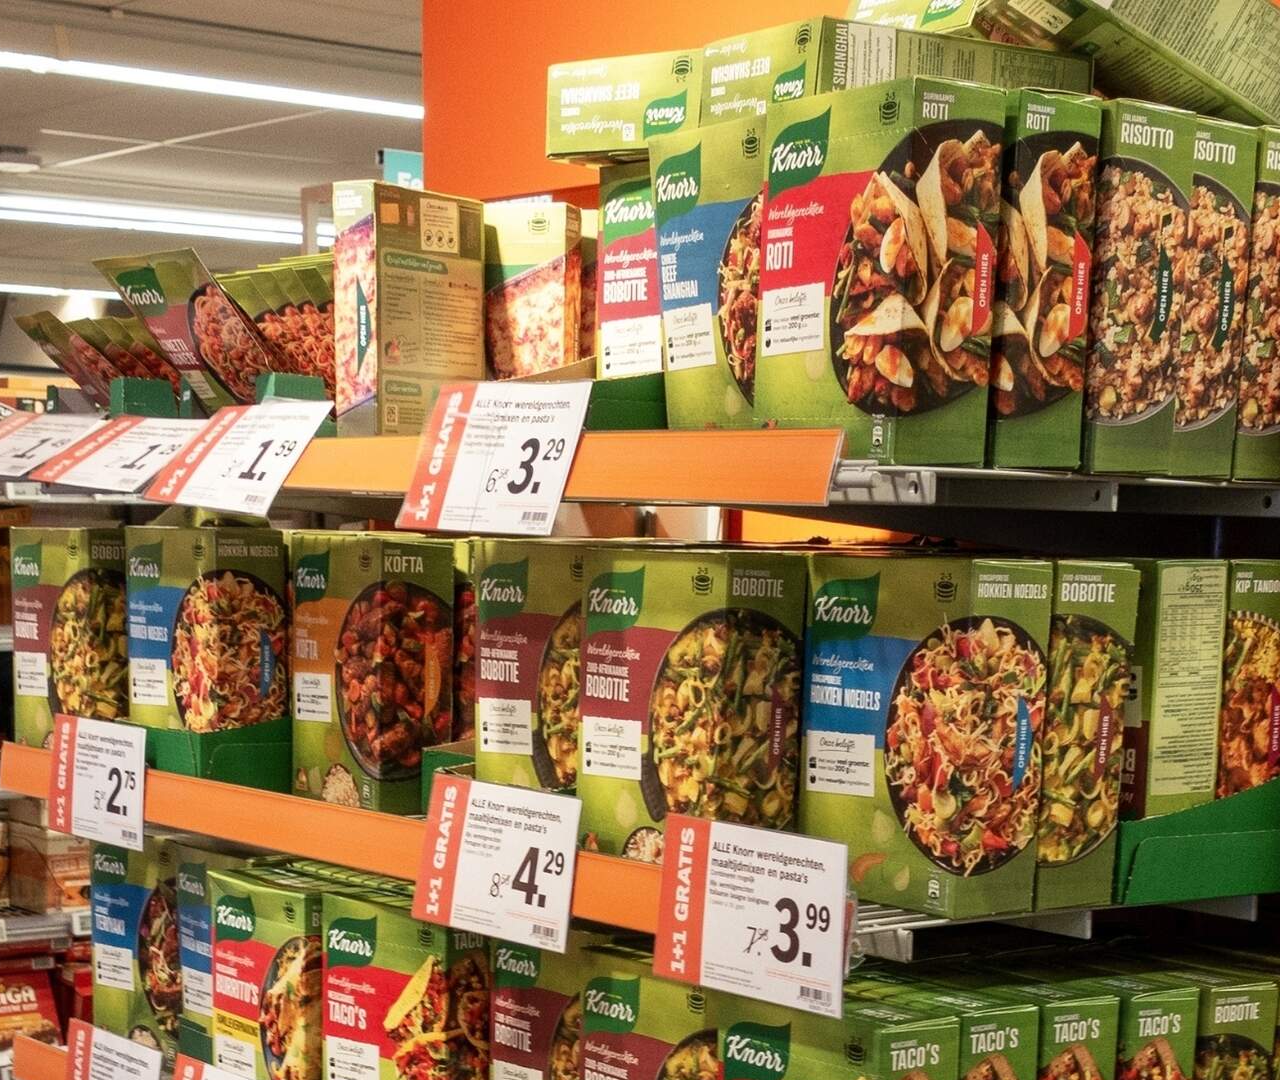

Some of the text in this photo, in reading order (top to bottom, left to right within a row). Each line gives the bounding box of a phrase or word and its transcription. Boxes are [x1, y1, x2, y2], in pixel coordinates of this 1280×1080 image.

[833, 23, 848, 84] SHANGHAI
[774, 79, 805, 98] Knorr
[645, 105, 686, 124] Knorr
[922, 103, 949, 120] ROTI
[1026, 113, 1051, 132] ROTI
[1121, 124, 1174, 152] RISOTTO
[771, 143, 823, 174] Knorr
[657, 174, 699, 203] Knorr
[605, 200, 656, 225] Knorr
[768, 202, 825, 222] Wereldgerechten
[766, 241, 794, 272] ROTI
[662, 266, 678, 283] BEEF
[979, 252, 990, 308] OPEN HIER
[1075, 261, 1087, 315] OPEN HIER
[121, 286, 165, 307] Knorr
[604, 279, 648, 304] BOBOTIE
[663, 280, 699, 301] SHANGHAI
[1158, 269, 1171, 323] OPEN HIER
[1220, 280, 1232, 332] OPEN HIER
[14, 557, 40, 577] Knorr
[129, 557, 160, 578] Knorr
[296, 566, 326, 590] Knorr
[383, 556, 424, 573] KOFTA
[480, 577, 525, 604] Knorr
[732, 577, 784, 598] BOBOTIE
[978, 582, 1048, 601] HOKKIEN NOEDELS
[1061, 582, 1117, 604] BOBOTIE
[1235, 579, 1251, 593] KIP
[589, 586, 639, 616] Knorr
[814, 595, 873, 626] Knorr
[480, 658, 520, 684] BOBOTIE
[812, 652, 875, 674] Wereldgerechten
[585, 674, 630, 703] BOBOTIE
[842, 688, 882, 712] NOEDELS
[773, 706, 783, 755] OPEN HIER
[1273, 705, 1280, 729] HIER
[1018, 717, 1029, 769] OPEN HIER
[1099, 714, 1111, 766] OPEN HIER
[426, 785, 458, 917] 1+1 GRATIS
[712, 840, 732, 855] ALLE
[732, 843, 756, 859] Knorr
[94, 853, 125, 876] Knorr
[711, 857, 808, 886] maaltijdmixen en pasta's
[178, 872, 205, 897] Knorr
[671, 827, 696, 975] 1+1 GRATIS
[216, 904, 254, 933] Knorr
[328, 928, 373, 958] Knorr
[770, 897, 831, 968] 3.99
[497, 948, 537, 978] Knorr
[215, 974, 260, 1007] BURRITO'S
[328, 1001, 367, 1031] TACO'S
[586, 988, 635, 1023] Knorr
[1214, 1001, 1260, 1025] BOBOTIE
[495, 1022, 532, 1054] BOBOTIE
[1053, 1018, 1101, 1044] TACO'S
[1138, 1013, 1182, 1038] TACO'S
[726, 1034, 784, 1073] Knorr
[970, 1026, 1019, 1054] TACO'S
[890, 1043, 941, 1072] TACO'S
